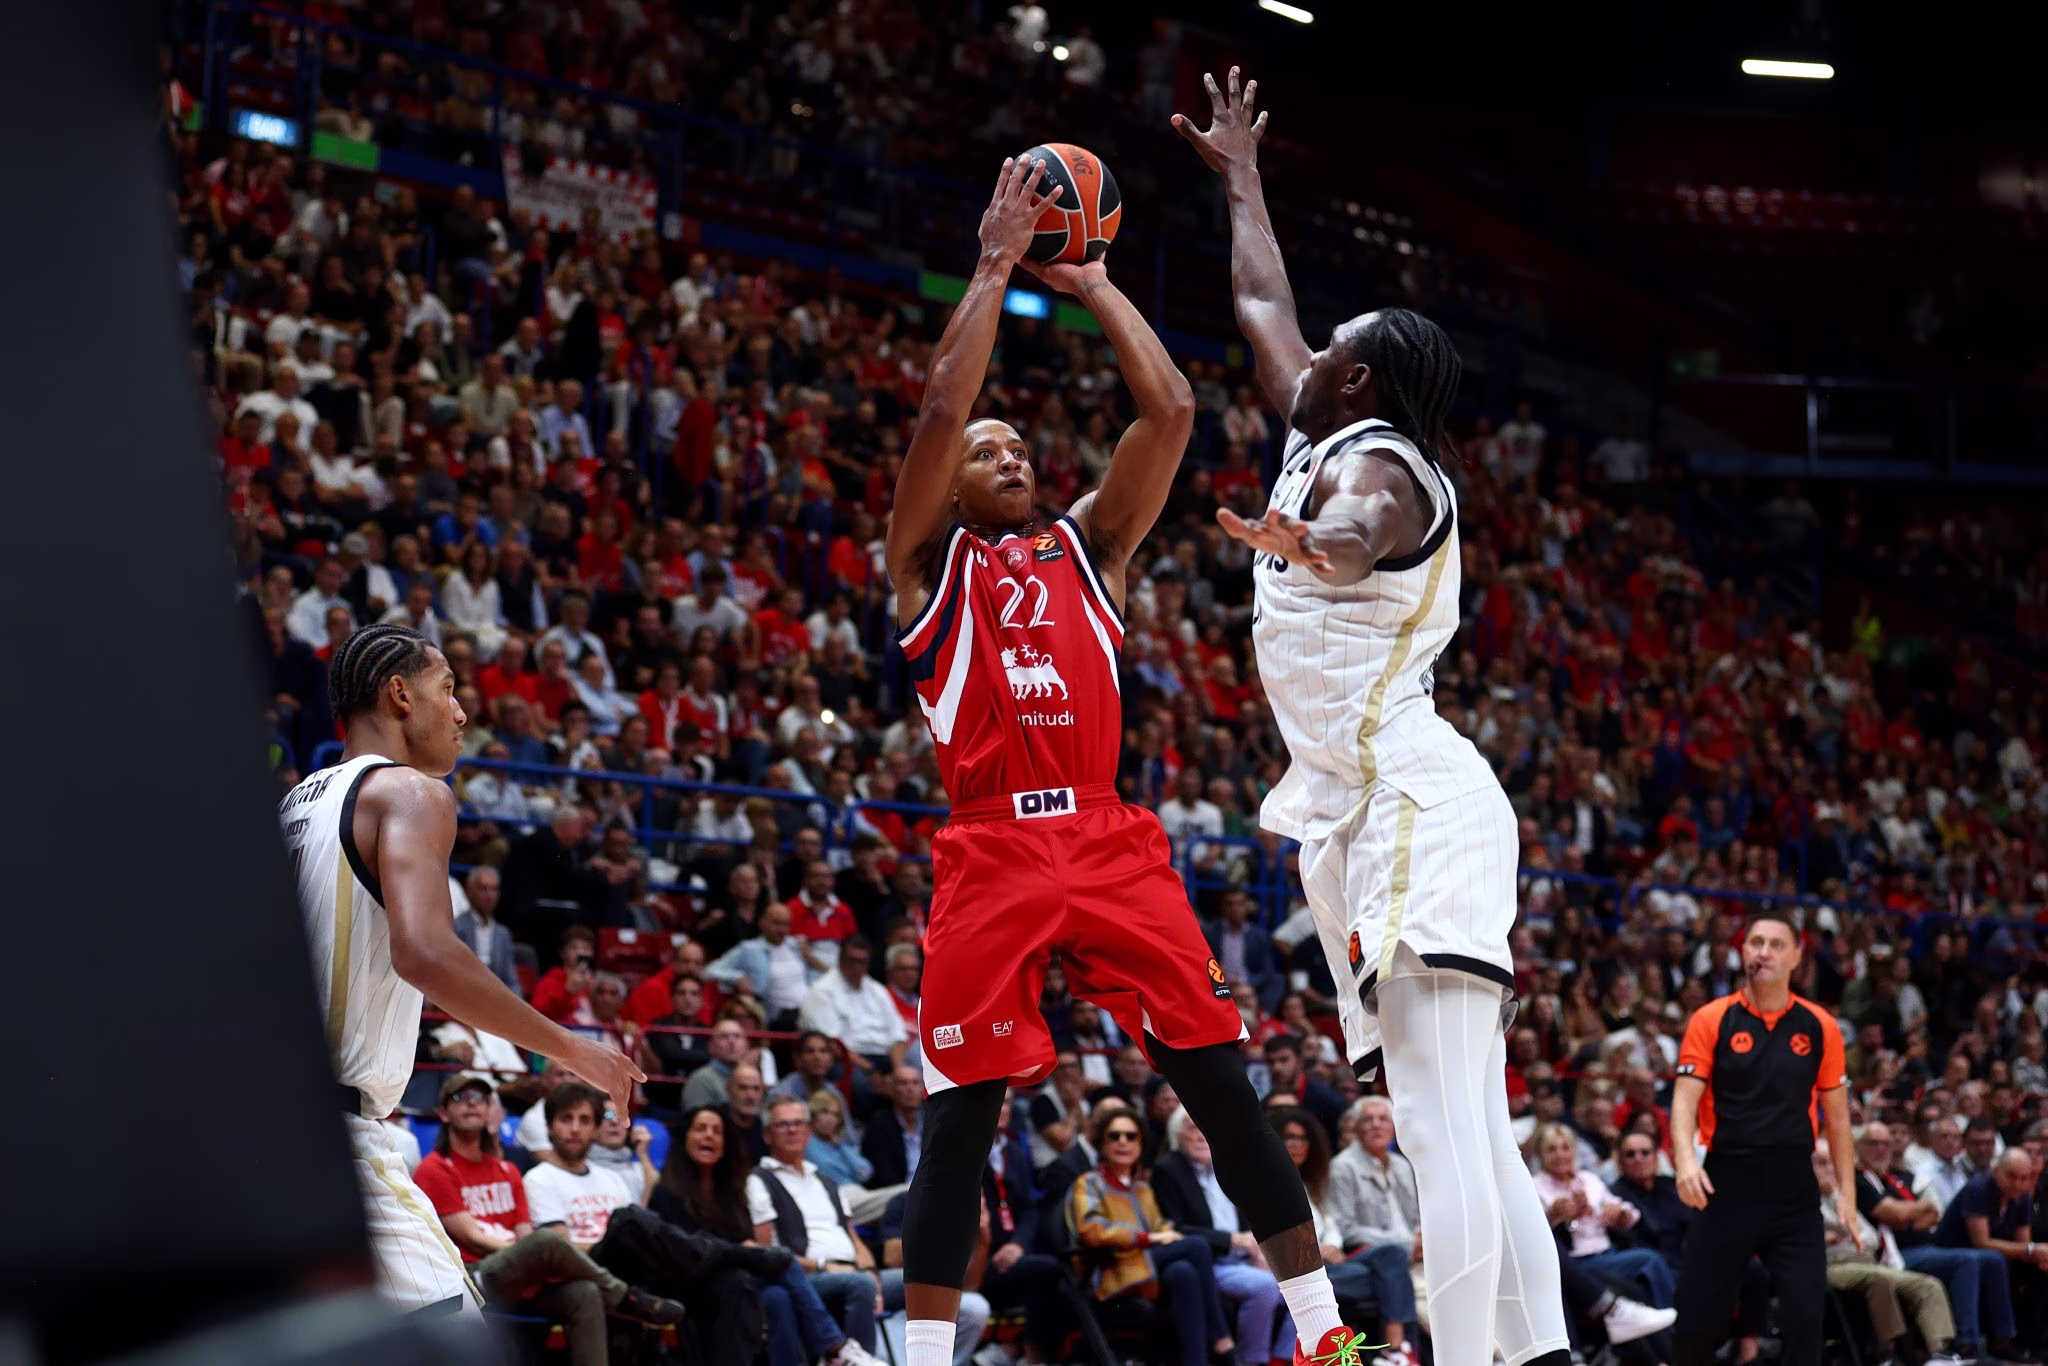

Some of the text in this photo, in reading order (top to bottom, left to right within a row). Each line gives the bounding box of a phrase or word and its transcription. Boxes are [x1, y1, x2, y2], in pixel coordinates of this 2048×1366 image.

[996, 575, 1056, 630] 22
[1018, 710, 1074, 726] nitud
[1020, 789, 1069, 815] OM
[935, 1026, 957, 1040] EA7
[992, 1020, 1014, 1034] EA7
